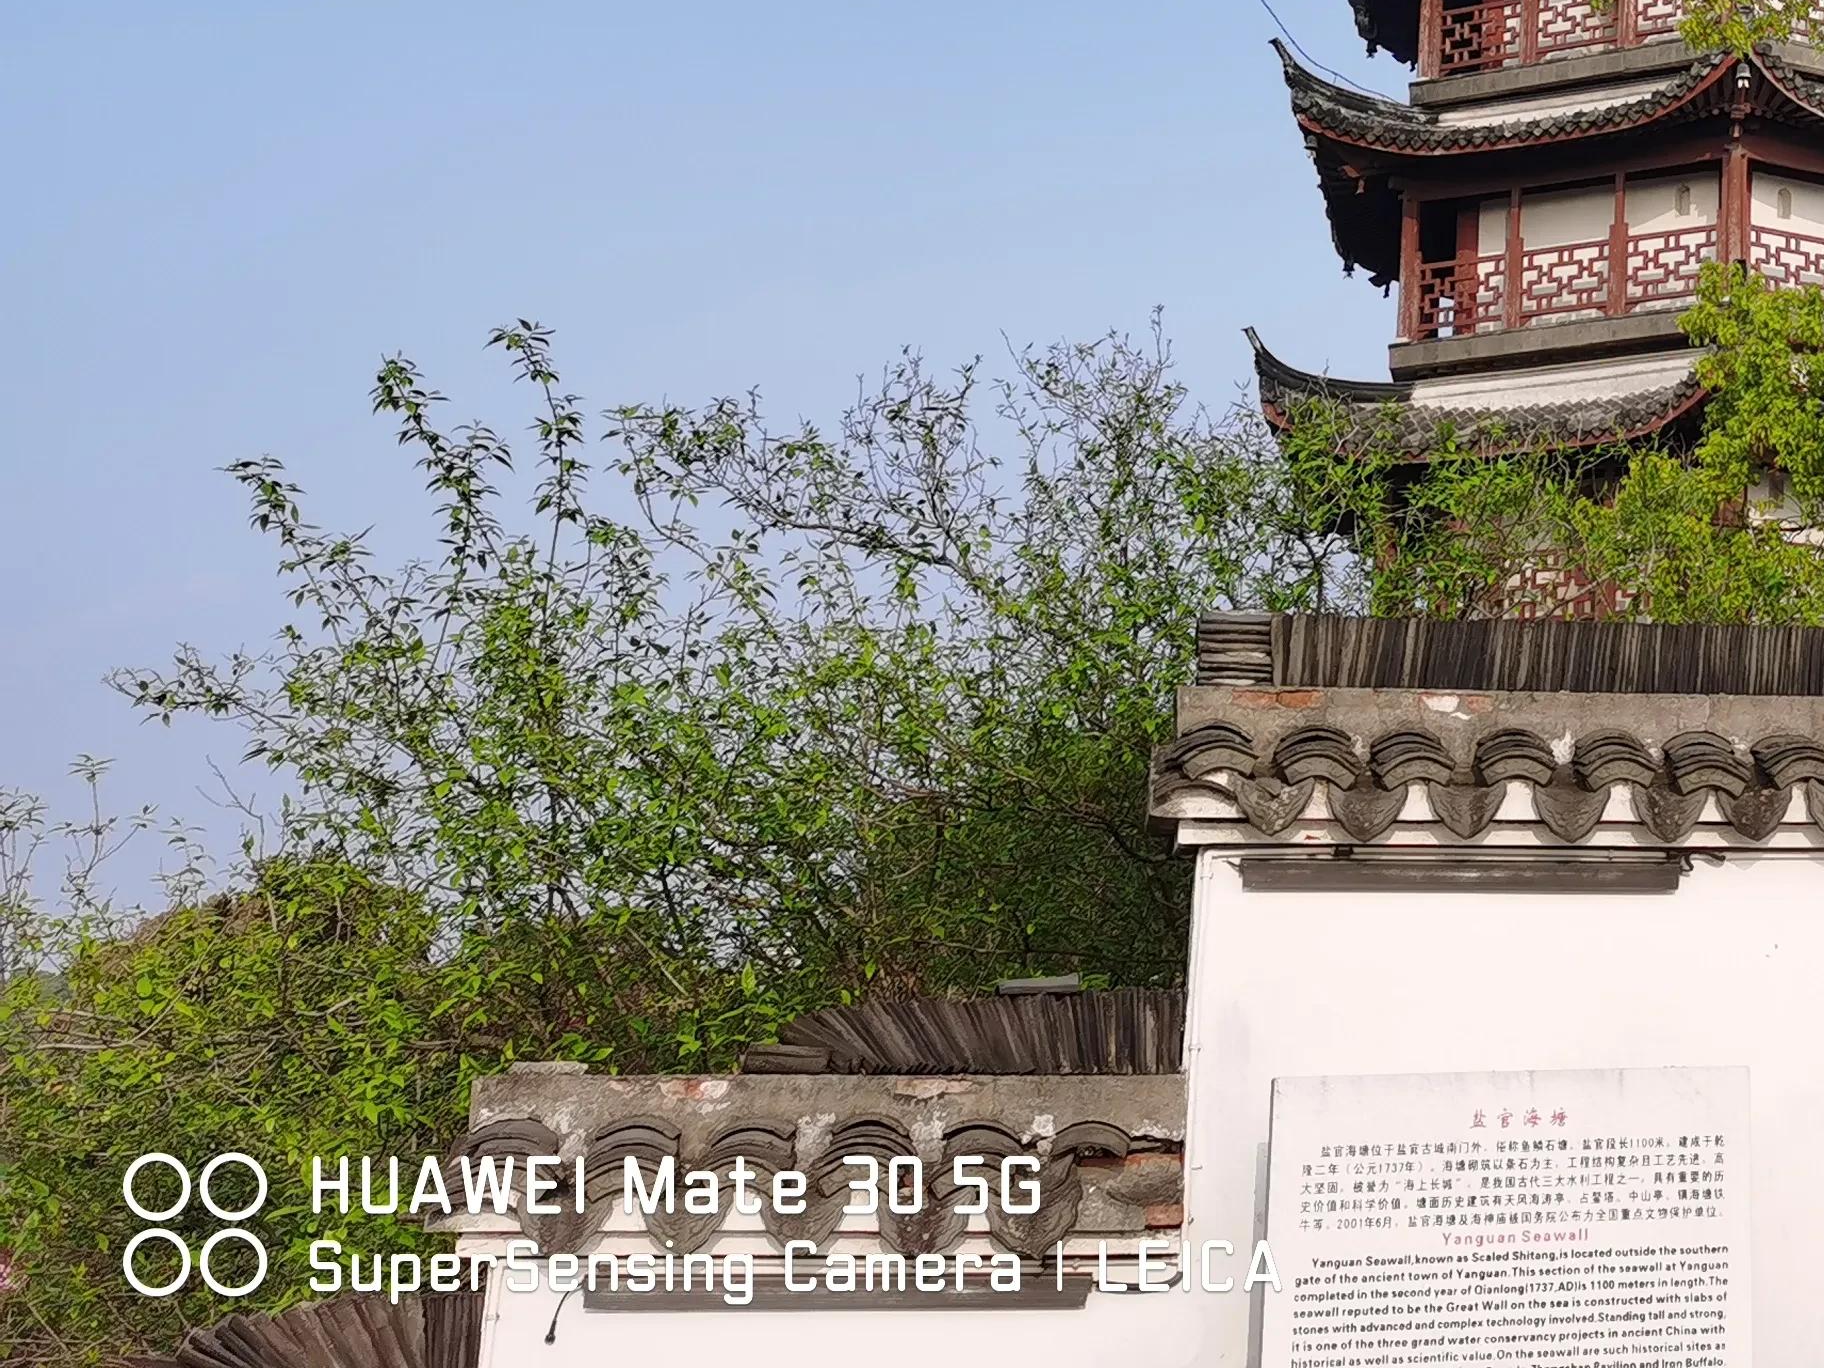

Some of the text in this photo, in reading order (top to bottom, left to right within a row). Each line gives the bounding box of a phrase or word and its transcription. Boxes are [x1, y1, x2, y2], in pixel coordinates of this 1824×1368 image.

[1470, 1107, 1568, 1129] 盐官海塘
[1443, 1228, 1588, 1248] Yanguan Seawall
[1312, 1258, 1362, 1270] Yanguan
[1471, 1251, 1509, 1263] Scaled
[1571, 1248, 1612, 1259] located
[1615, 1246, 1656, 1258] outside
[1659, 1245, 1677, 1256] the
[1680, 1244, 1728, 1255] southern
[1295, 1276, 1321, 1288] gate
[1324, 1274, 1336, 1284] of
[1339, 1273, 1358, 1284] the
[1361, 1271, 1405, 1283] ancient
[1408, 1272, 1438, 1281] town
[1441, 1269, 1453, 1280] of
[1538, 1265, 1580, 1276] section
[1584, 1264, 1594, 1275] of
[1598, 1264, 1616, 1274] the
[1619, 1261, 1662, 1273] seawall
[1665, 1262, 1676, 1272] at
[1680, 1260, 1728, 1272] Yanguan
[1294, 1289, 1355, 1303] completed
[1357, 1289, 1367, 1300] in
[1370, 1289, 1389, 1299] the
[1392, 1286, 1431, 1298] second
[1434, 1288, 1458, 1299] year
[1460, 1285, 1472, 1296] of
[1591, 1280, 1615, 1291] 1100
[1618, 1280, 1655, 1290] meters
[1658, 1277, 1668, 1288] in
[1293, 1291, 1727, 1319] seawall reputed to be the Great Wall on the sea is constructed with slabs of
[1293, 1326, 1329, 1336] stones
[1332, 1322, 1357, 1333] with
[1360, 1320, 1412, 1333] advanced
[1415, 1319, 1435, 1330] and
[1437, 1318, 1484, 1330] complex
[1486, 1316, 1546, 1328] technology
[1648, 1310, 1665, 1320] tall
[1668, 1309, 1687, 1320] and
[1292, 1324, 1725, 1353] it is one of the three grand water conservancy projects in ancient China with
[1291, 1356, 1346, 1368] historical
[1349, 1358, 1361, 1367] as
[1364, 1354, 1389, 1366] well
[1392, 1356, 1404, 1364] as
[1407, 1352, 1459, 1364] scientific
[1515, 1349, 1534, 1359] the
[1537, 1346, 1579, 1358] seawall
[1583, 1348, 1600, 1356] are
[1603, 1344, 1628, 1355] such
[1632, 1341, 1683, 1354] historical
[1686, 1341, 1712, 1352] sites
[1715, 1343, 1725, 1351] as
